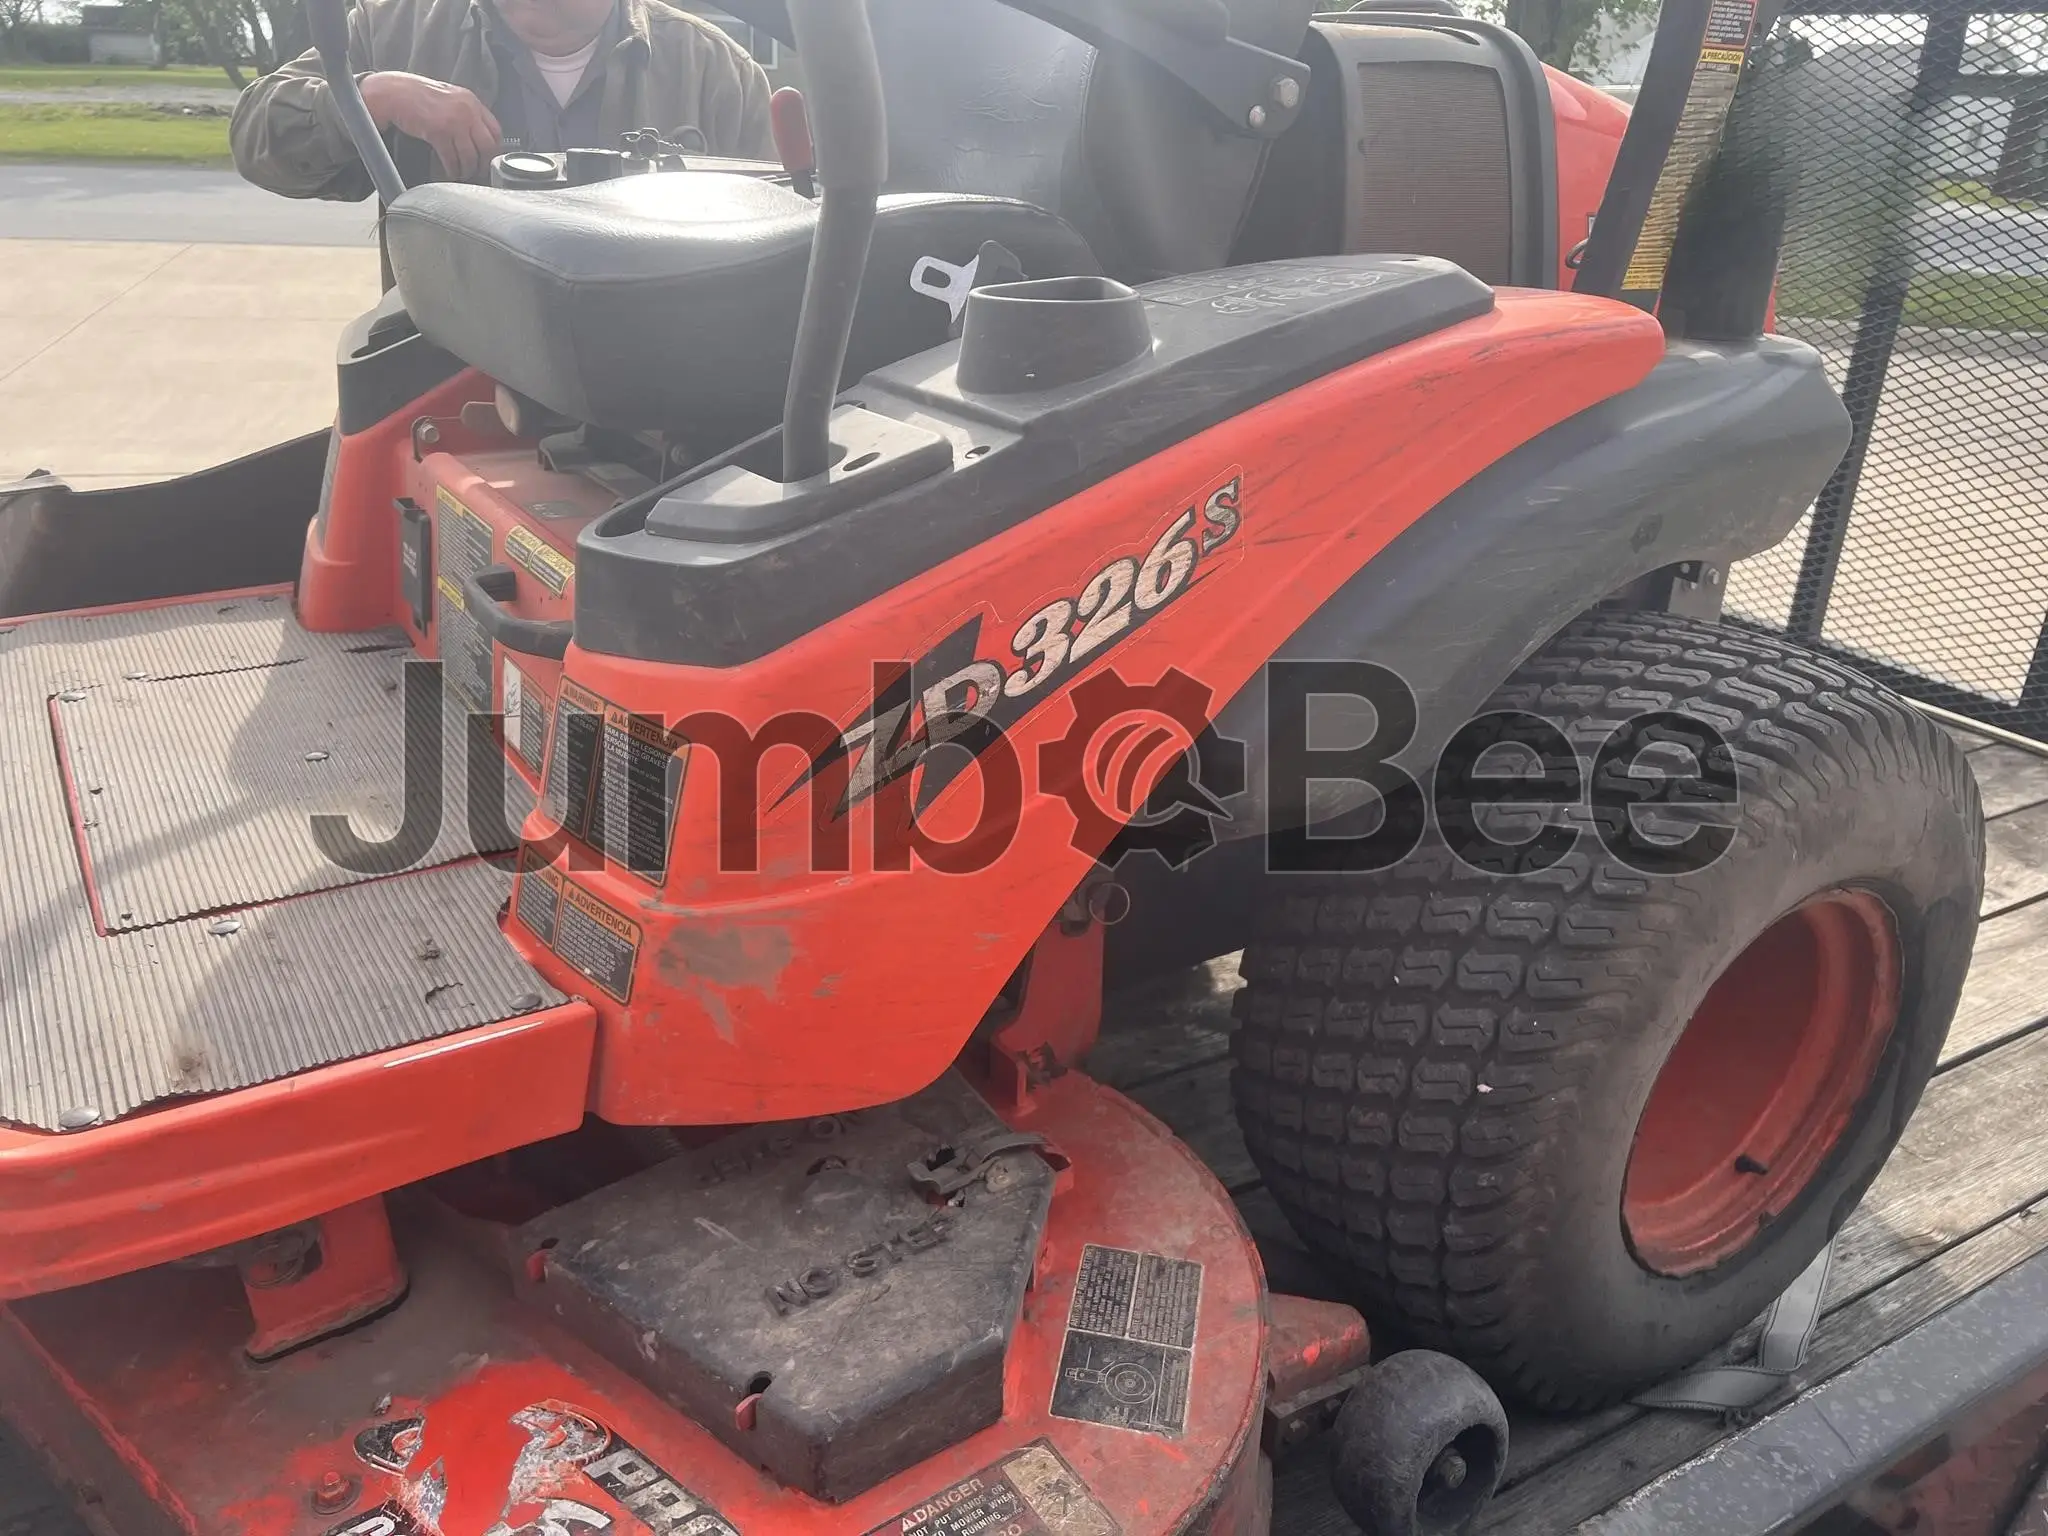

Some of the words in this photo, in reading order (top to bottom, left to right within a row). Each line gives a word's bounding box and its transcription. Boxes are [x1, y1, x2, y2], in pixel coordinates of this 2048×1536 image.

[617, 714, 679, 750] ADVERTENCIA
[640, 741, 672, 762] LESIONES
[764, 1267, 837, 1316] NO
[912, 1478, 985, 1520] DANGER
[934, 1512, 953, 1528] PUT
[957, 1494, 987, 1514] HANDS
[949, 1508, 985, 1532] MOWER
[988, 1491, 1016, 1510] WHEN
